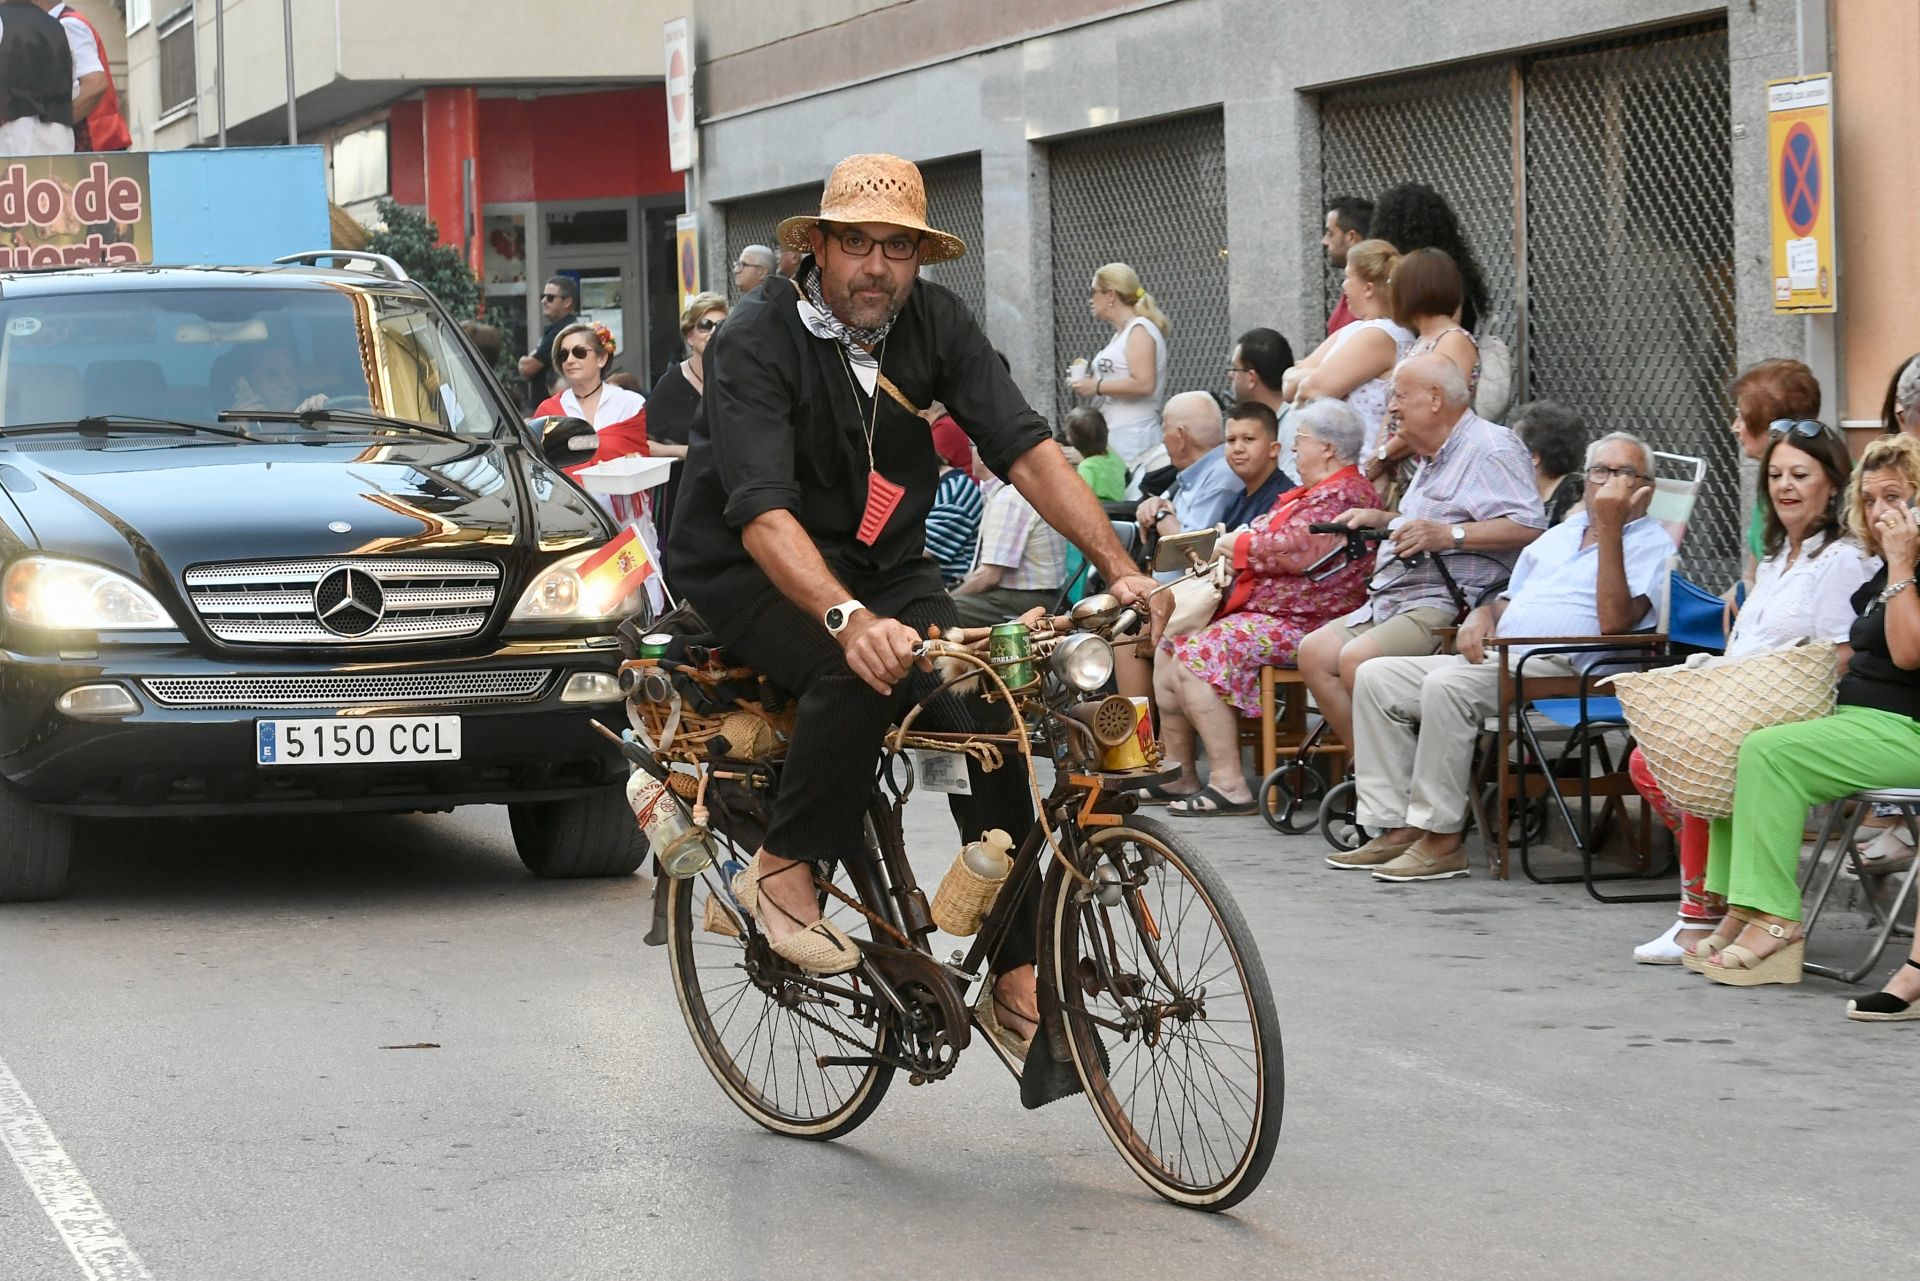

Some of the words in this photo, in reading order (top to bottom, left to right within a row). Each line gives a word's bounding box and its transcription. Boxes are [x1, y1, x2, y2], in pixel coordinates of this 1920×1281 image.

[0, 165, 62, 227] do
[72, 162, 141, 225] de
[263, 746, 272, 756] E
[286, 724, 375, 758] 5150
[389, 722, 453, 755] CCL
